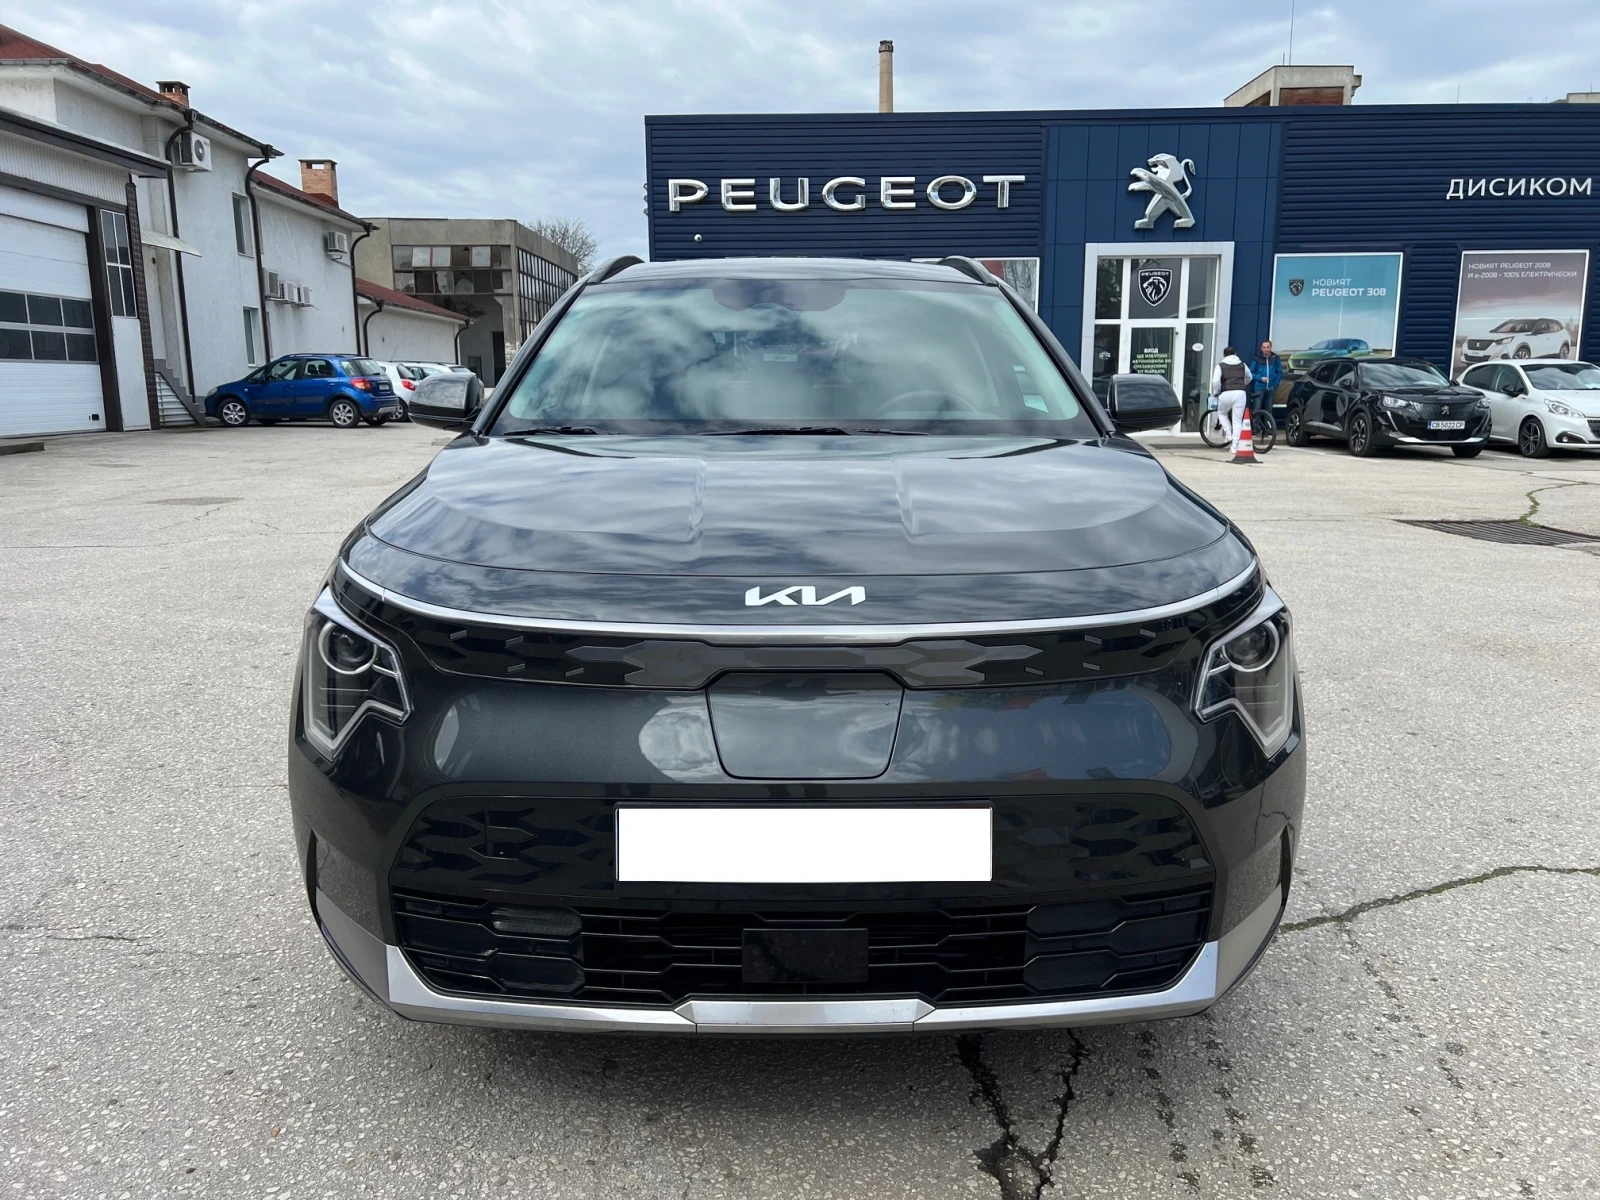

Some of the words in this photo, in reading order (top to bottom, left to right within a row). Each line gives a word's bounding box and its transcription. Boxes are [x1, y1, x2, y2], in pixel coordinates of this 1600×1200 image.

[668, 175, 1025, 212] PEUGEOT
[1446, 177, 1592, 200] ДИСИКОМ
[1468, 262, 1498, 270] НОВИЯТ
[1474, 271, 1498, 279] e-2008
[1521, 270, 1577, 278] ЕЛЕКТРИЧЕСКИ
[1312, 279, 1352, 287] НОВИЯТ
[1311, 288, 1364, 297] PEUGEOT
[1366, 287, 1387, 296] 308
[745, 586, 866, 606] KIA
